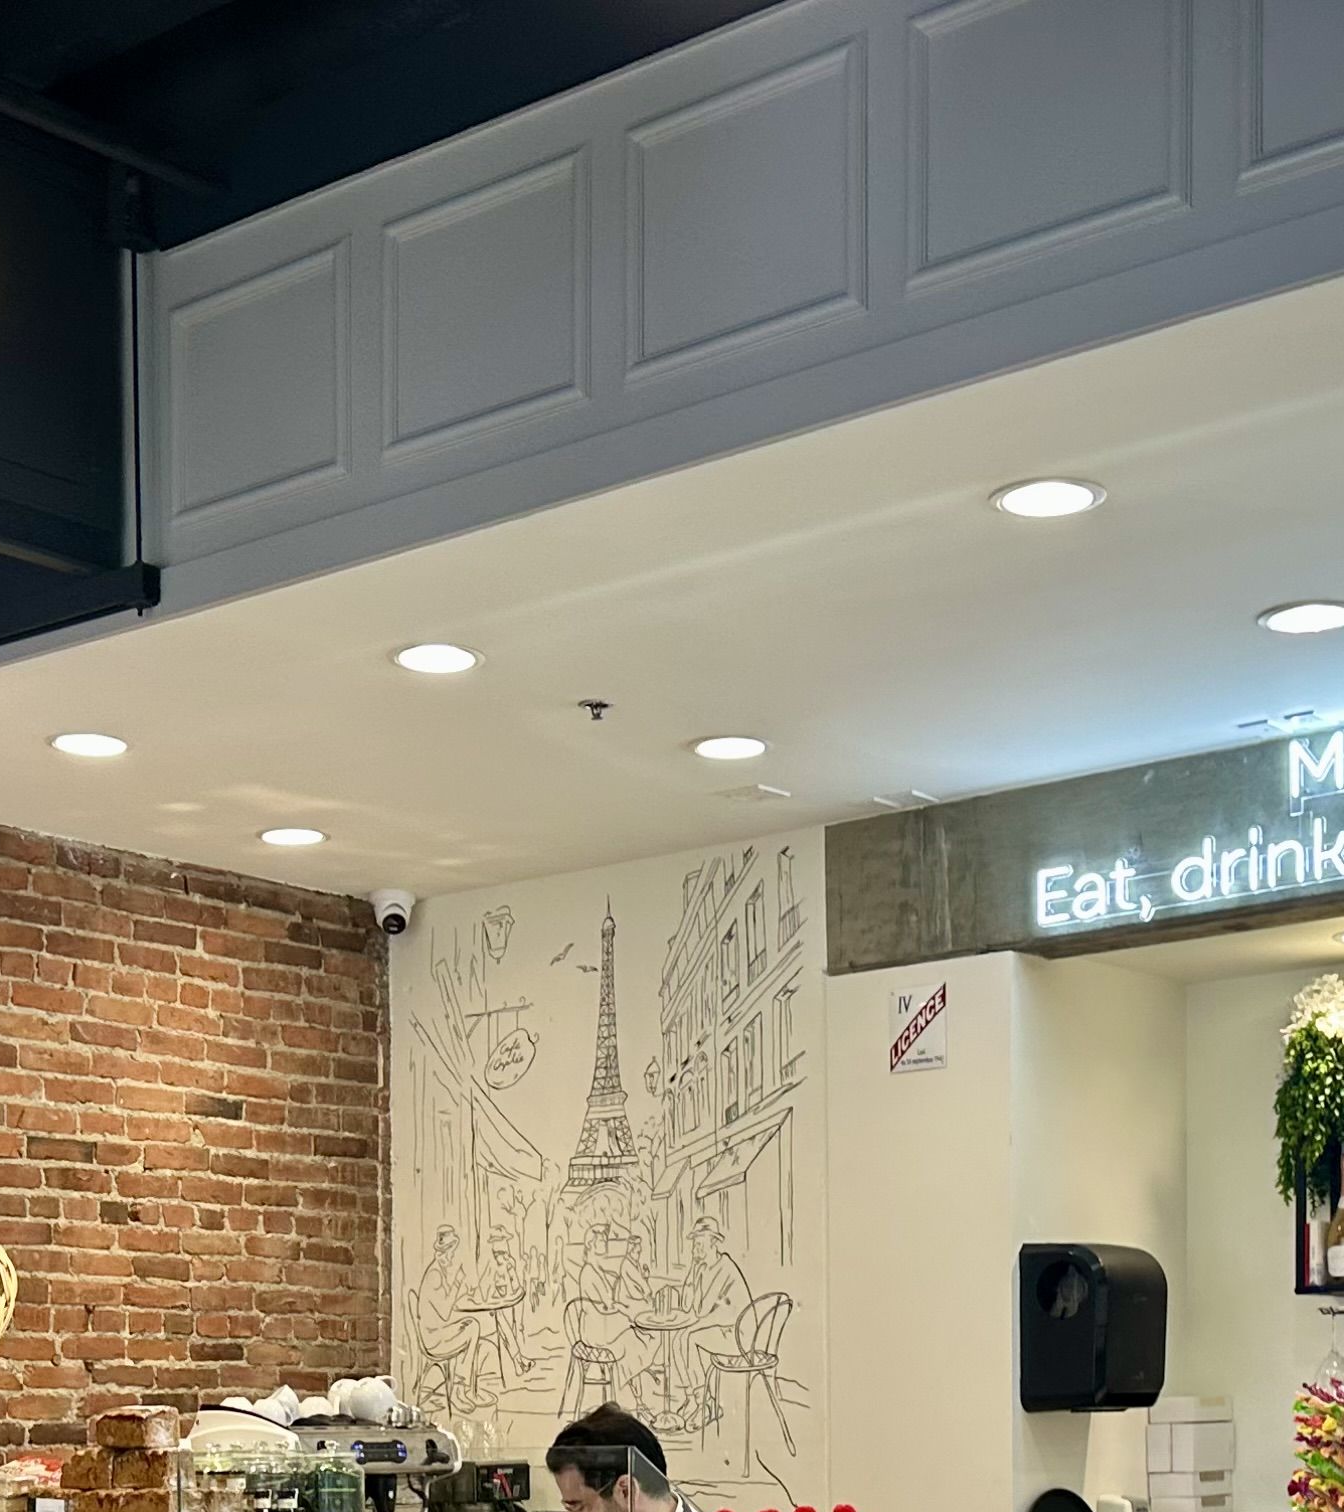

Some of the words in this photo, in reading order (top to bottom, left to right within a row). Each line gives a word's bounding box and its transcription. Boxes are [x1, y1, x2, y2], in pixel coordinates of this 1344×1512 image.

[1036, 857, 1155, 928] Eat,
[891, 987, 945, 1067] LICENCE
[898, 994, 912, 1014] IV
